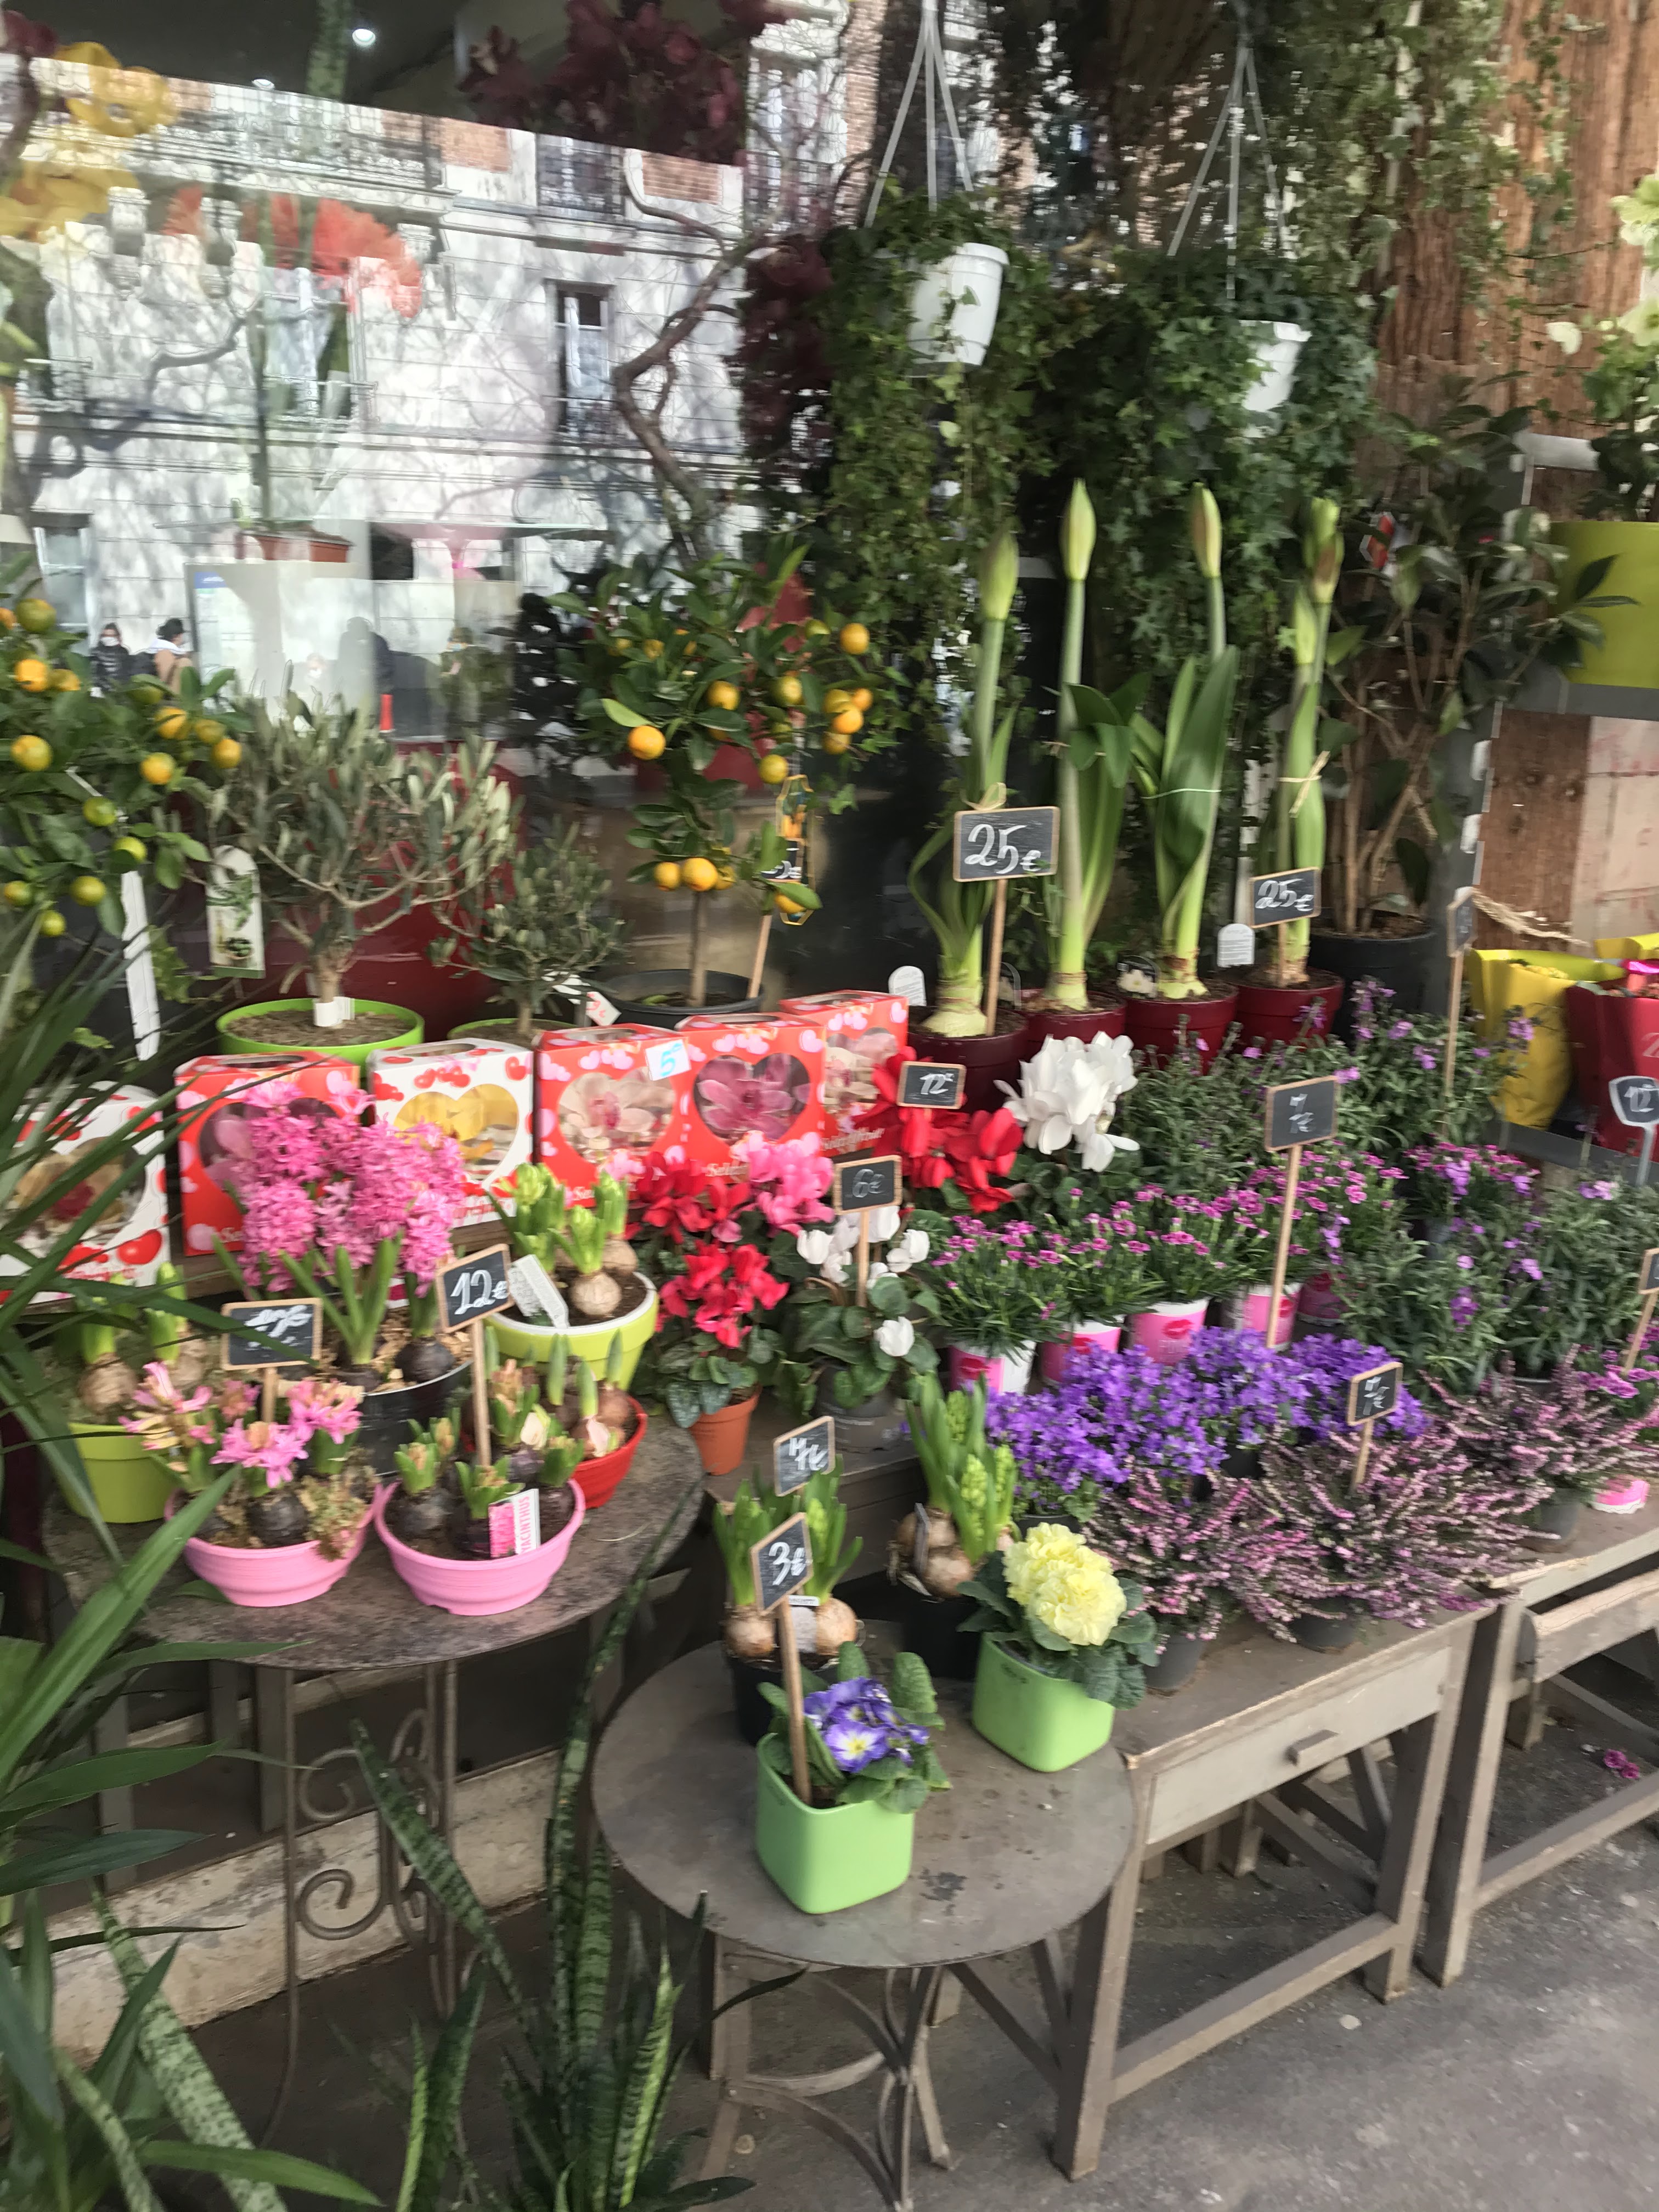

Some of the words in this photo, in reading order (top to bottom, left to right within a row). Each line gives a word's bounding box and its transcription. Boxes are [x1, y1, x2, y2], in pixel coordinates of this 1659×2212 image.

[964, 824, 1041, 874] 25€
[1255, 878, 1314, 912] 25€
[852, 1169, 885, 1198] 6€
[450, 1269, 510, 1315] 12€
[517, 1496, 531, 1554] YACINTHUS
[768, 1542, 807, 1586] 3€
